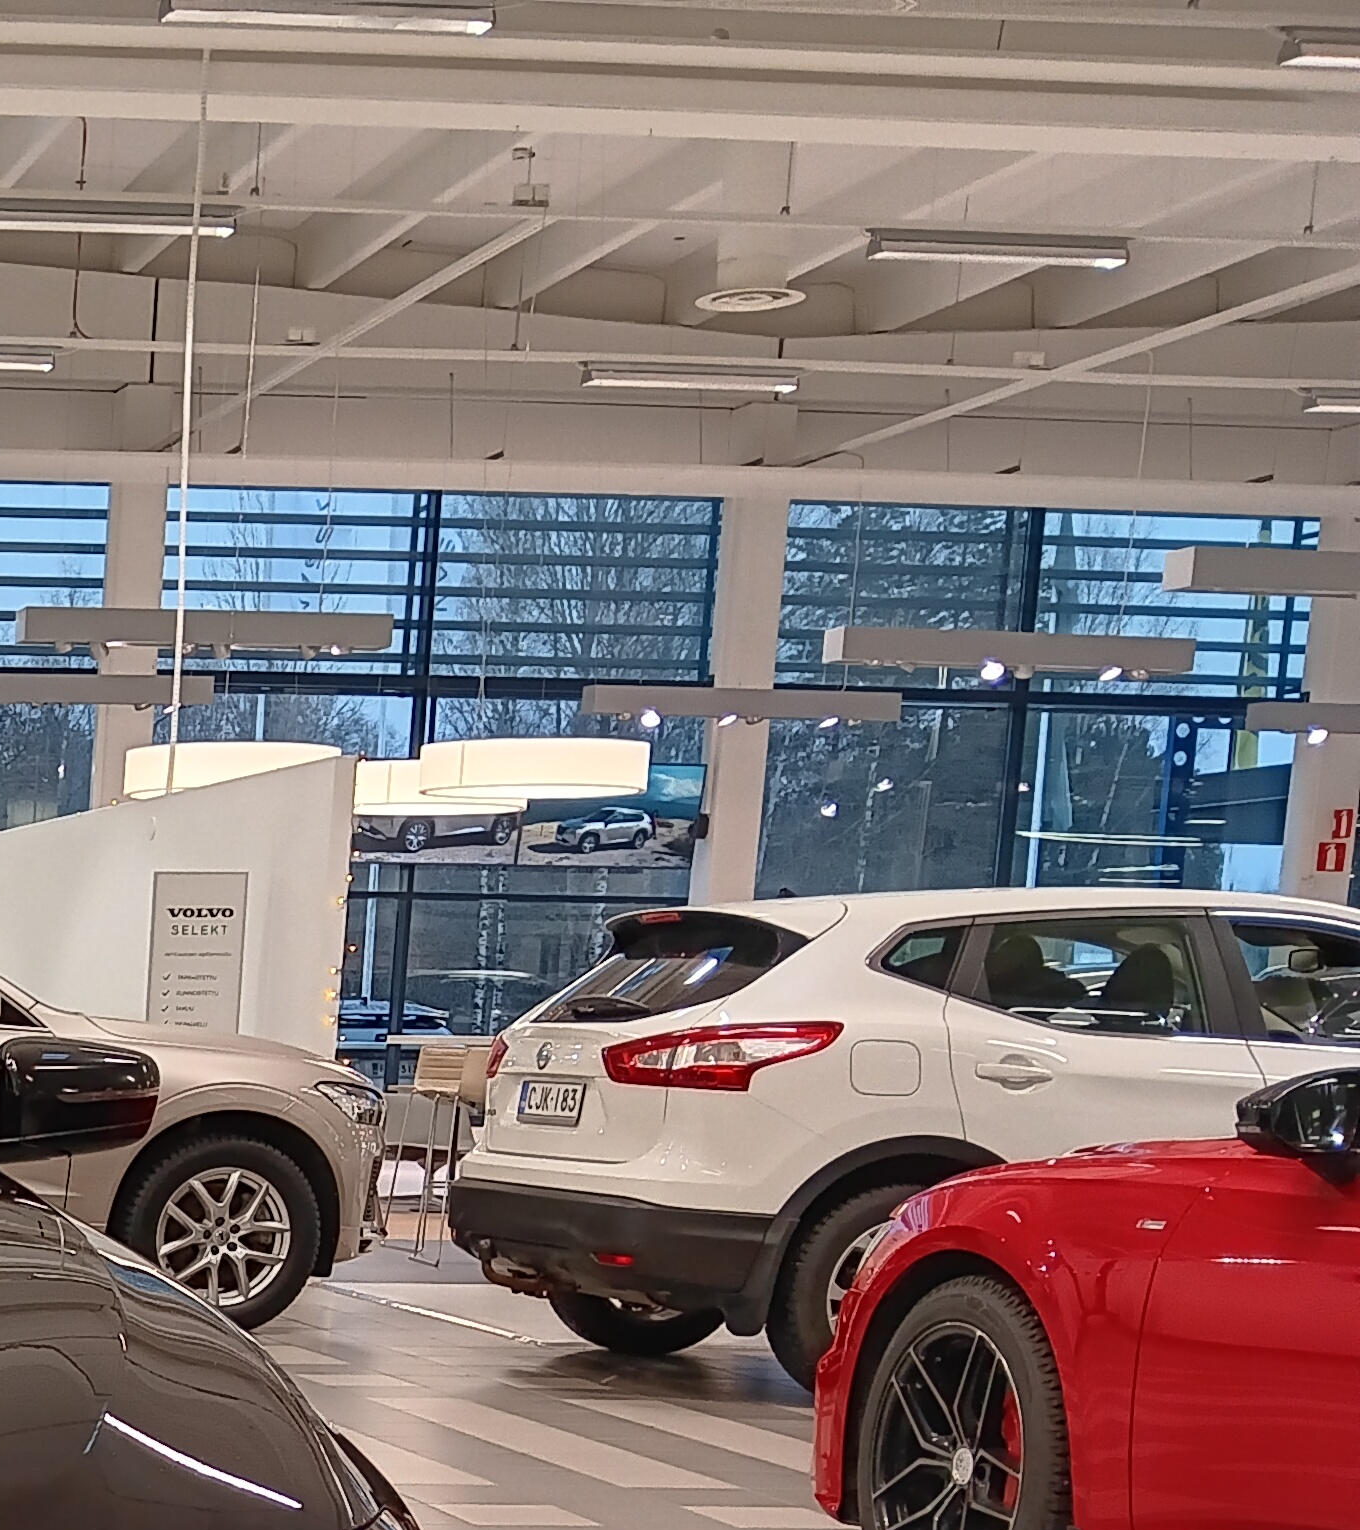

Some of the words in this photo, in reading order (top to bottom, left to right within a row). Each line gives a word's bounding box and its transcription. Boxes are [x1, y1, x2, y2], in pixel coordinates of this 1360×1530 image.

[166, 907, 234, 918] VOLVO
[171, 924, 228, 936] SELEKT
[527, 1085, 579, 1113] CJK-183
